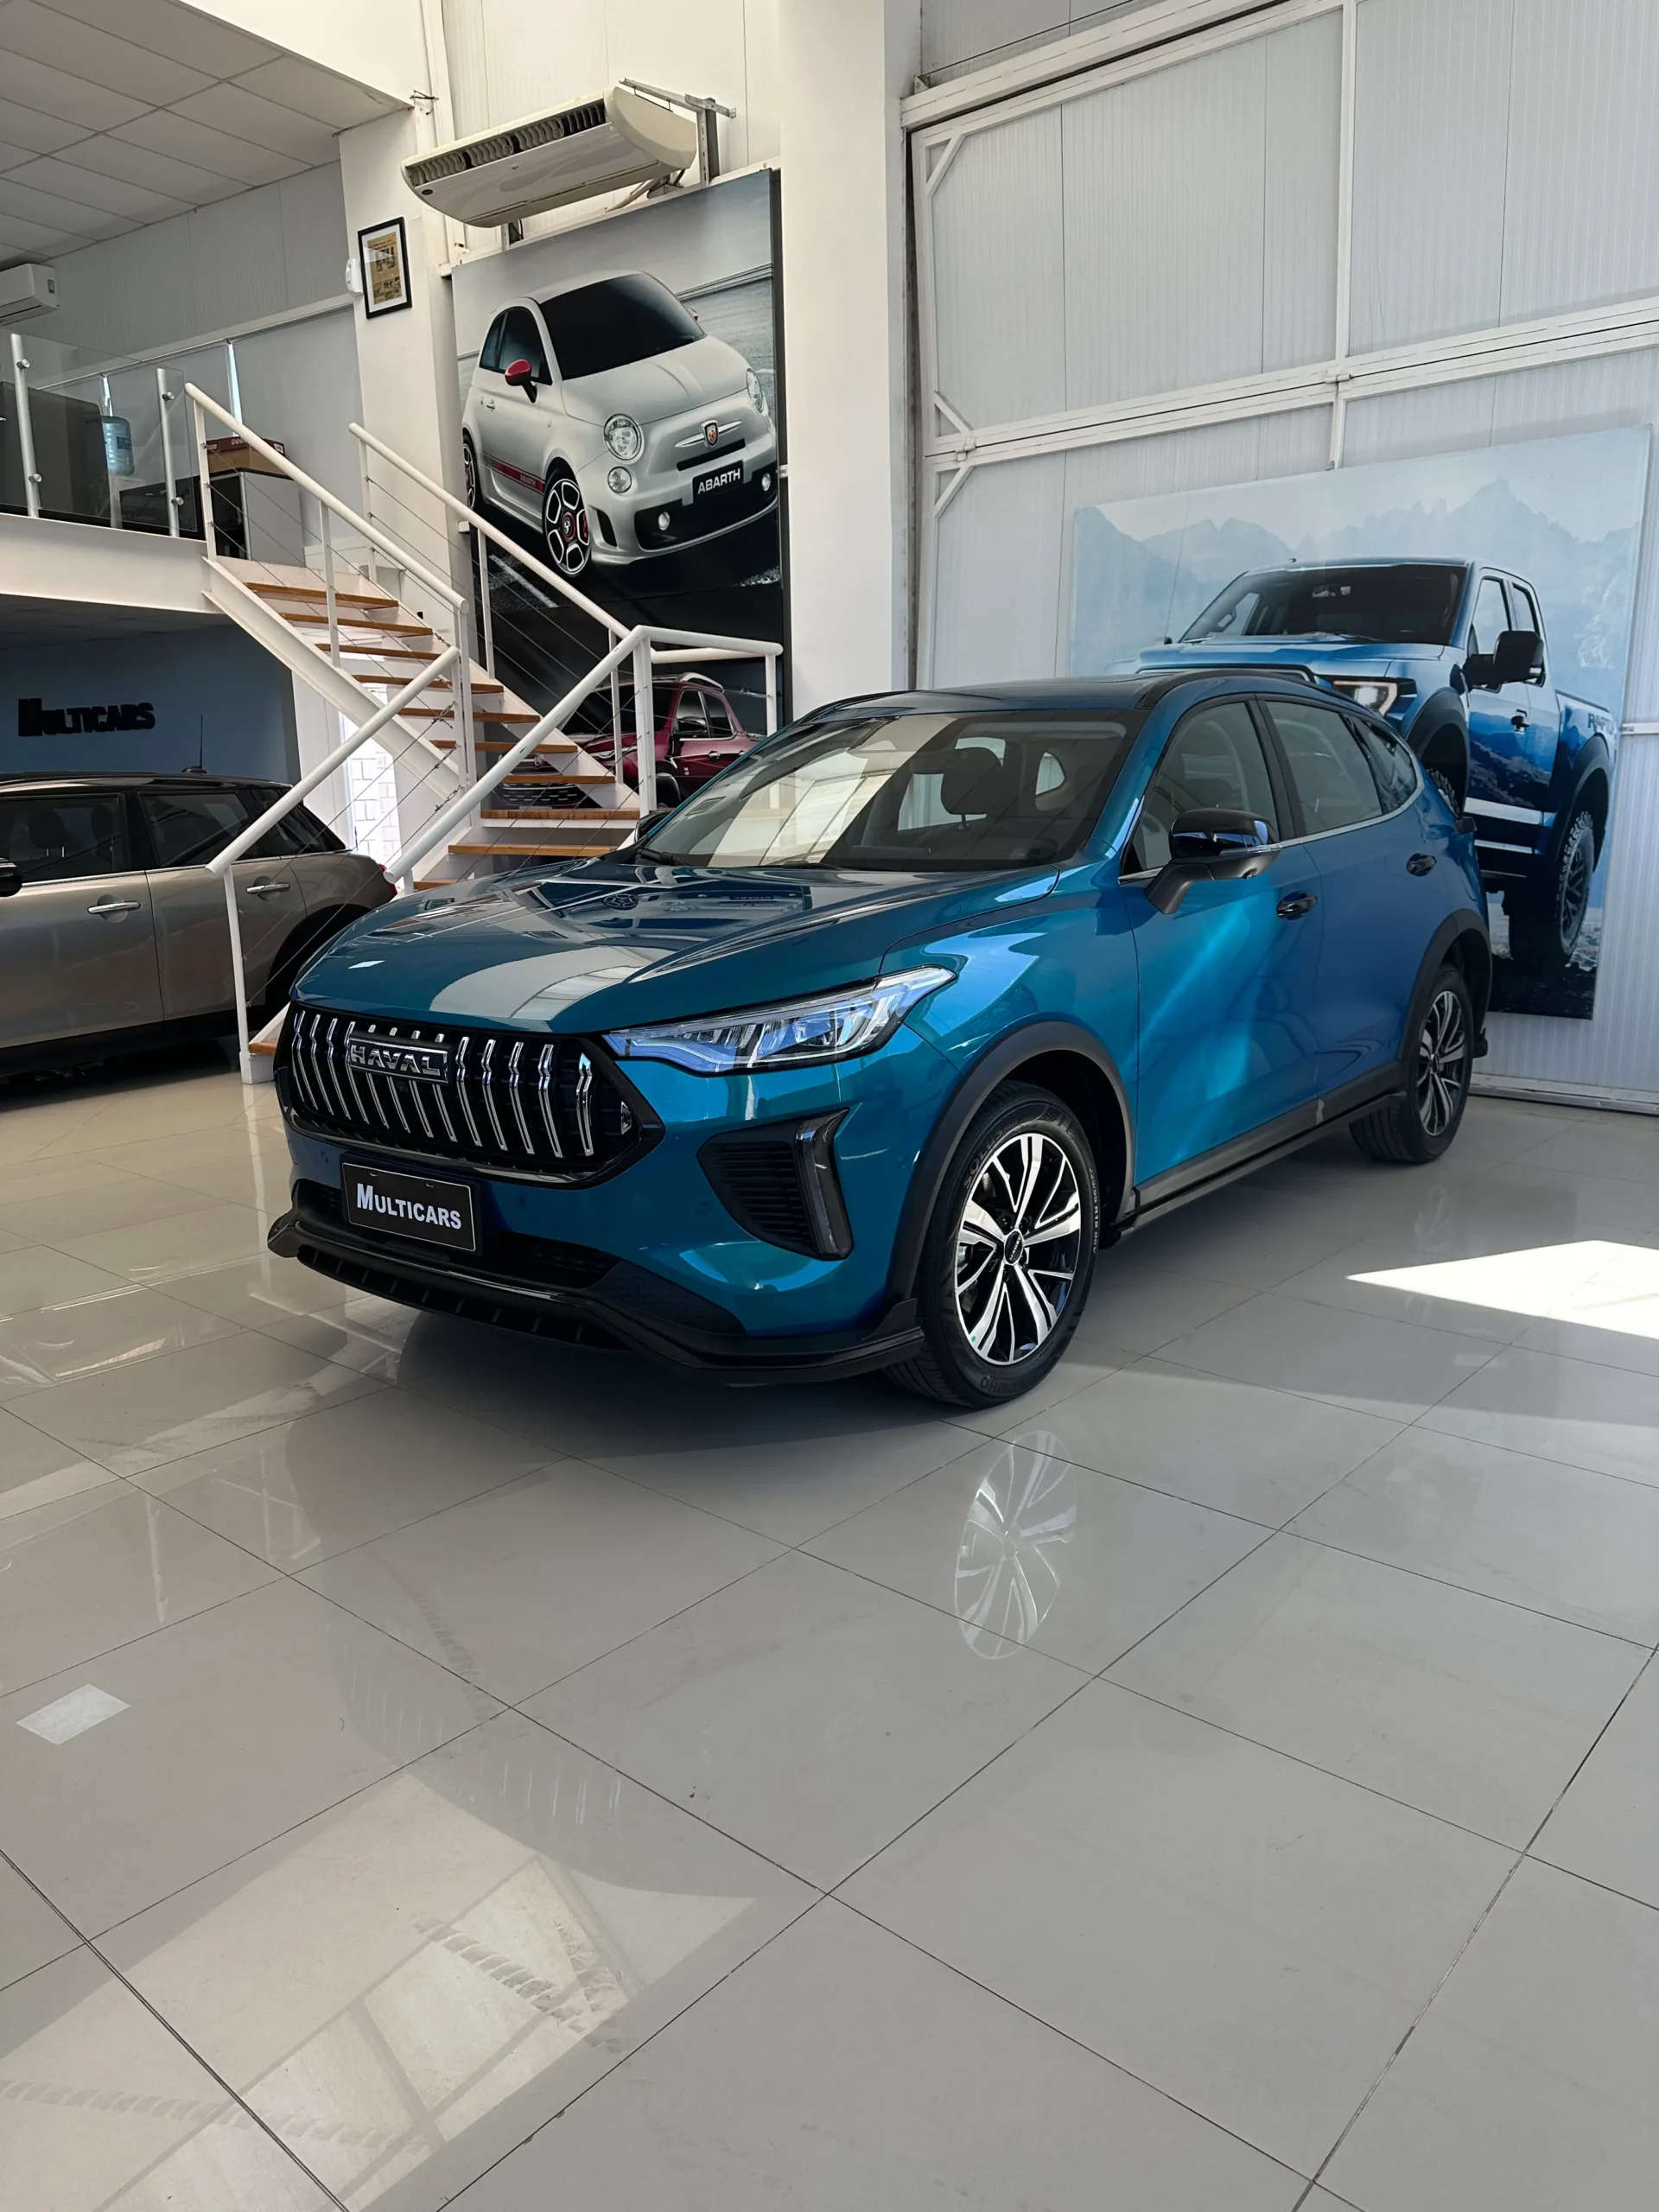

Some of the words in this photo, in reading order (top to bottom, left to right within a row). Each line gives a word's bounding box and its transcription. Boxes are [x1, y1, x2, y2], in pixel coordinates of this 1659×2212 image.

[697, 467, 741, 494] ABARTH
[350, 1044, 441, 1076] HAVAL
[357, 1182, 462, 1230] MULTICARS
